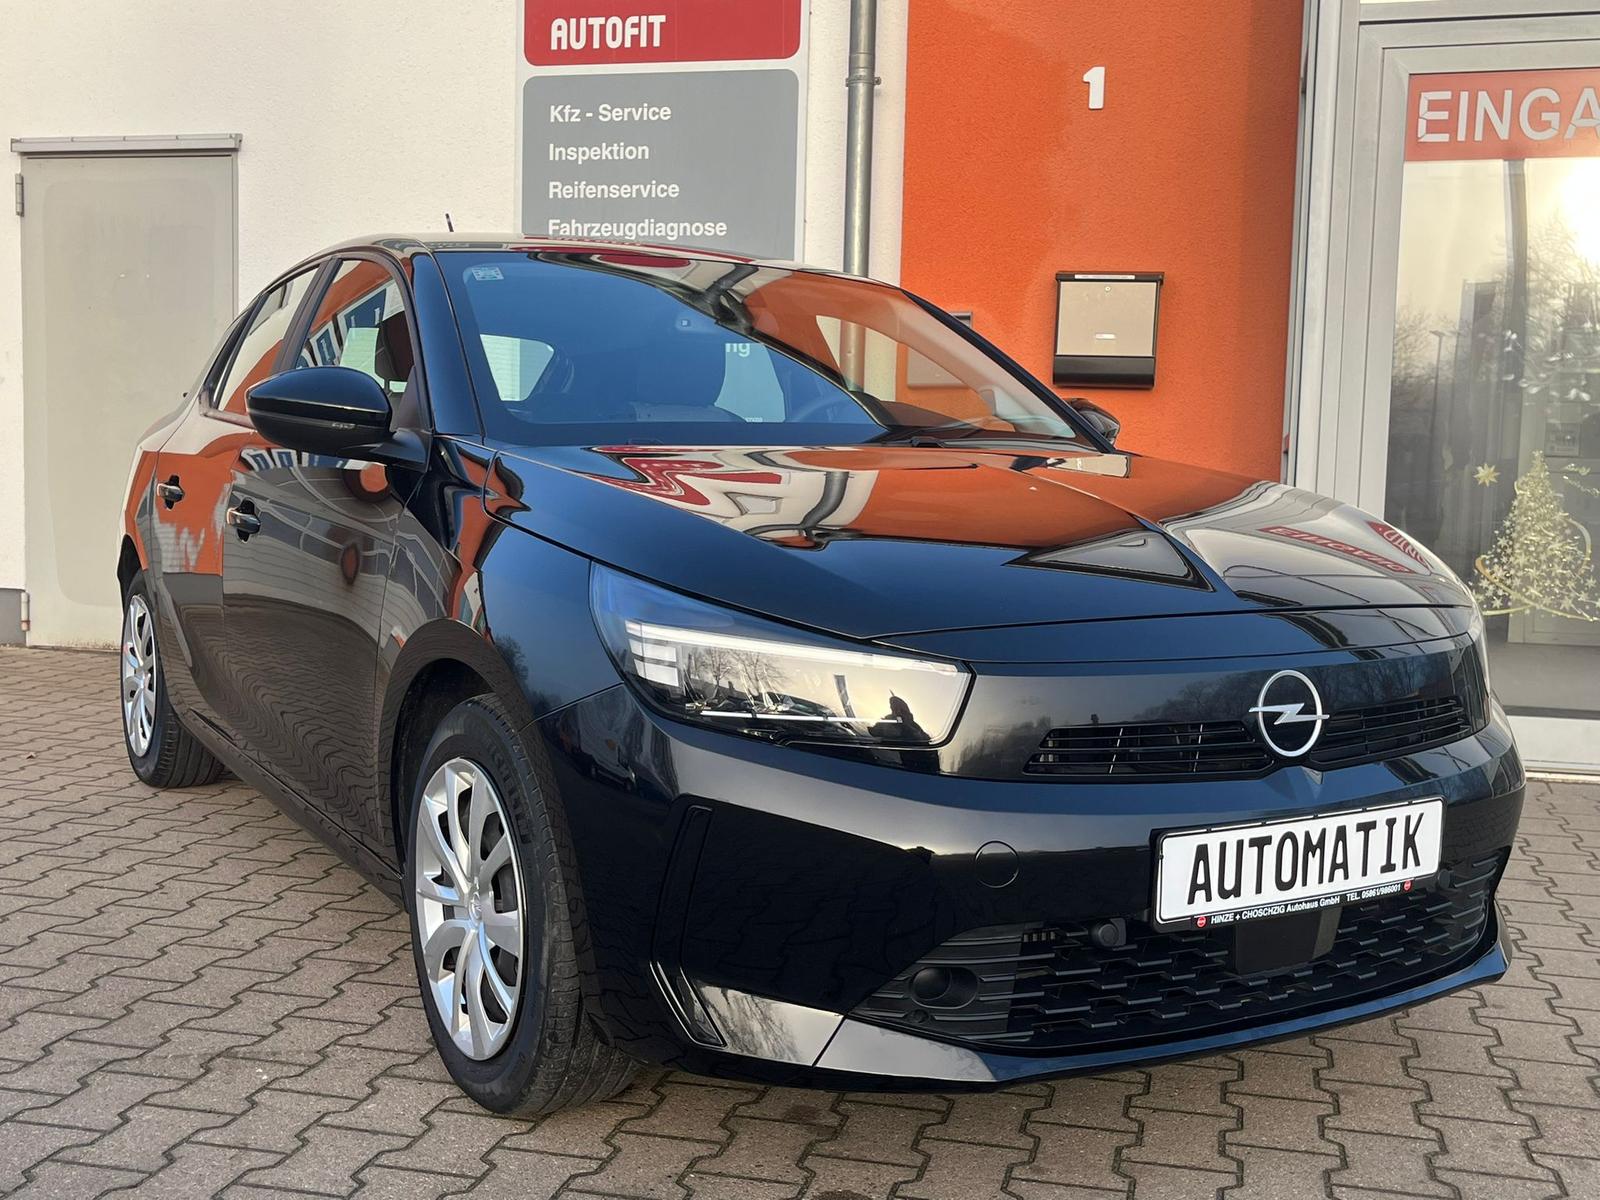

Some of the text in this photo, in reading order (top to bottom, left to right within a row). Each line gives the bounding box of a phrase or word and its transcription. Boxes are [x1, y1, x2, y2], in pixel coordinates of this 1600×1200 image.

[551, 15, 666, 50] AUTOFIT
[1082, 66, 1106, 110] 1
[550, 105, 581, 122] Kfz
[598, 103, 672, 121] Service
[1417, 87, 1600, 143] EINGA
[549, 142, 650, 165] Inspektion
[549, 180, 680, 199] Reifenservice
[548, 219, 728, 240] Fahrzeugdiagnose
[1187, 812, 1424, 906] AUTOMATIK
[1211, 912, 1235, 925] HINZE
[1286, 901, 1319, 913] Autohaus
[1320, 896, 1340, 908] GmbH
